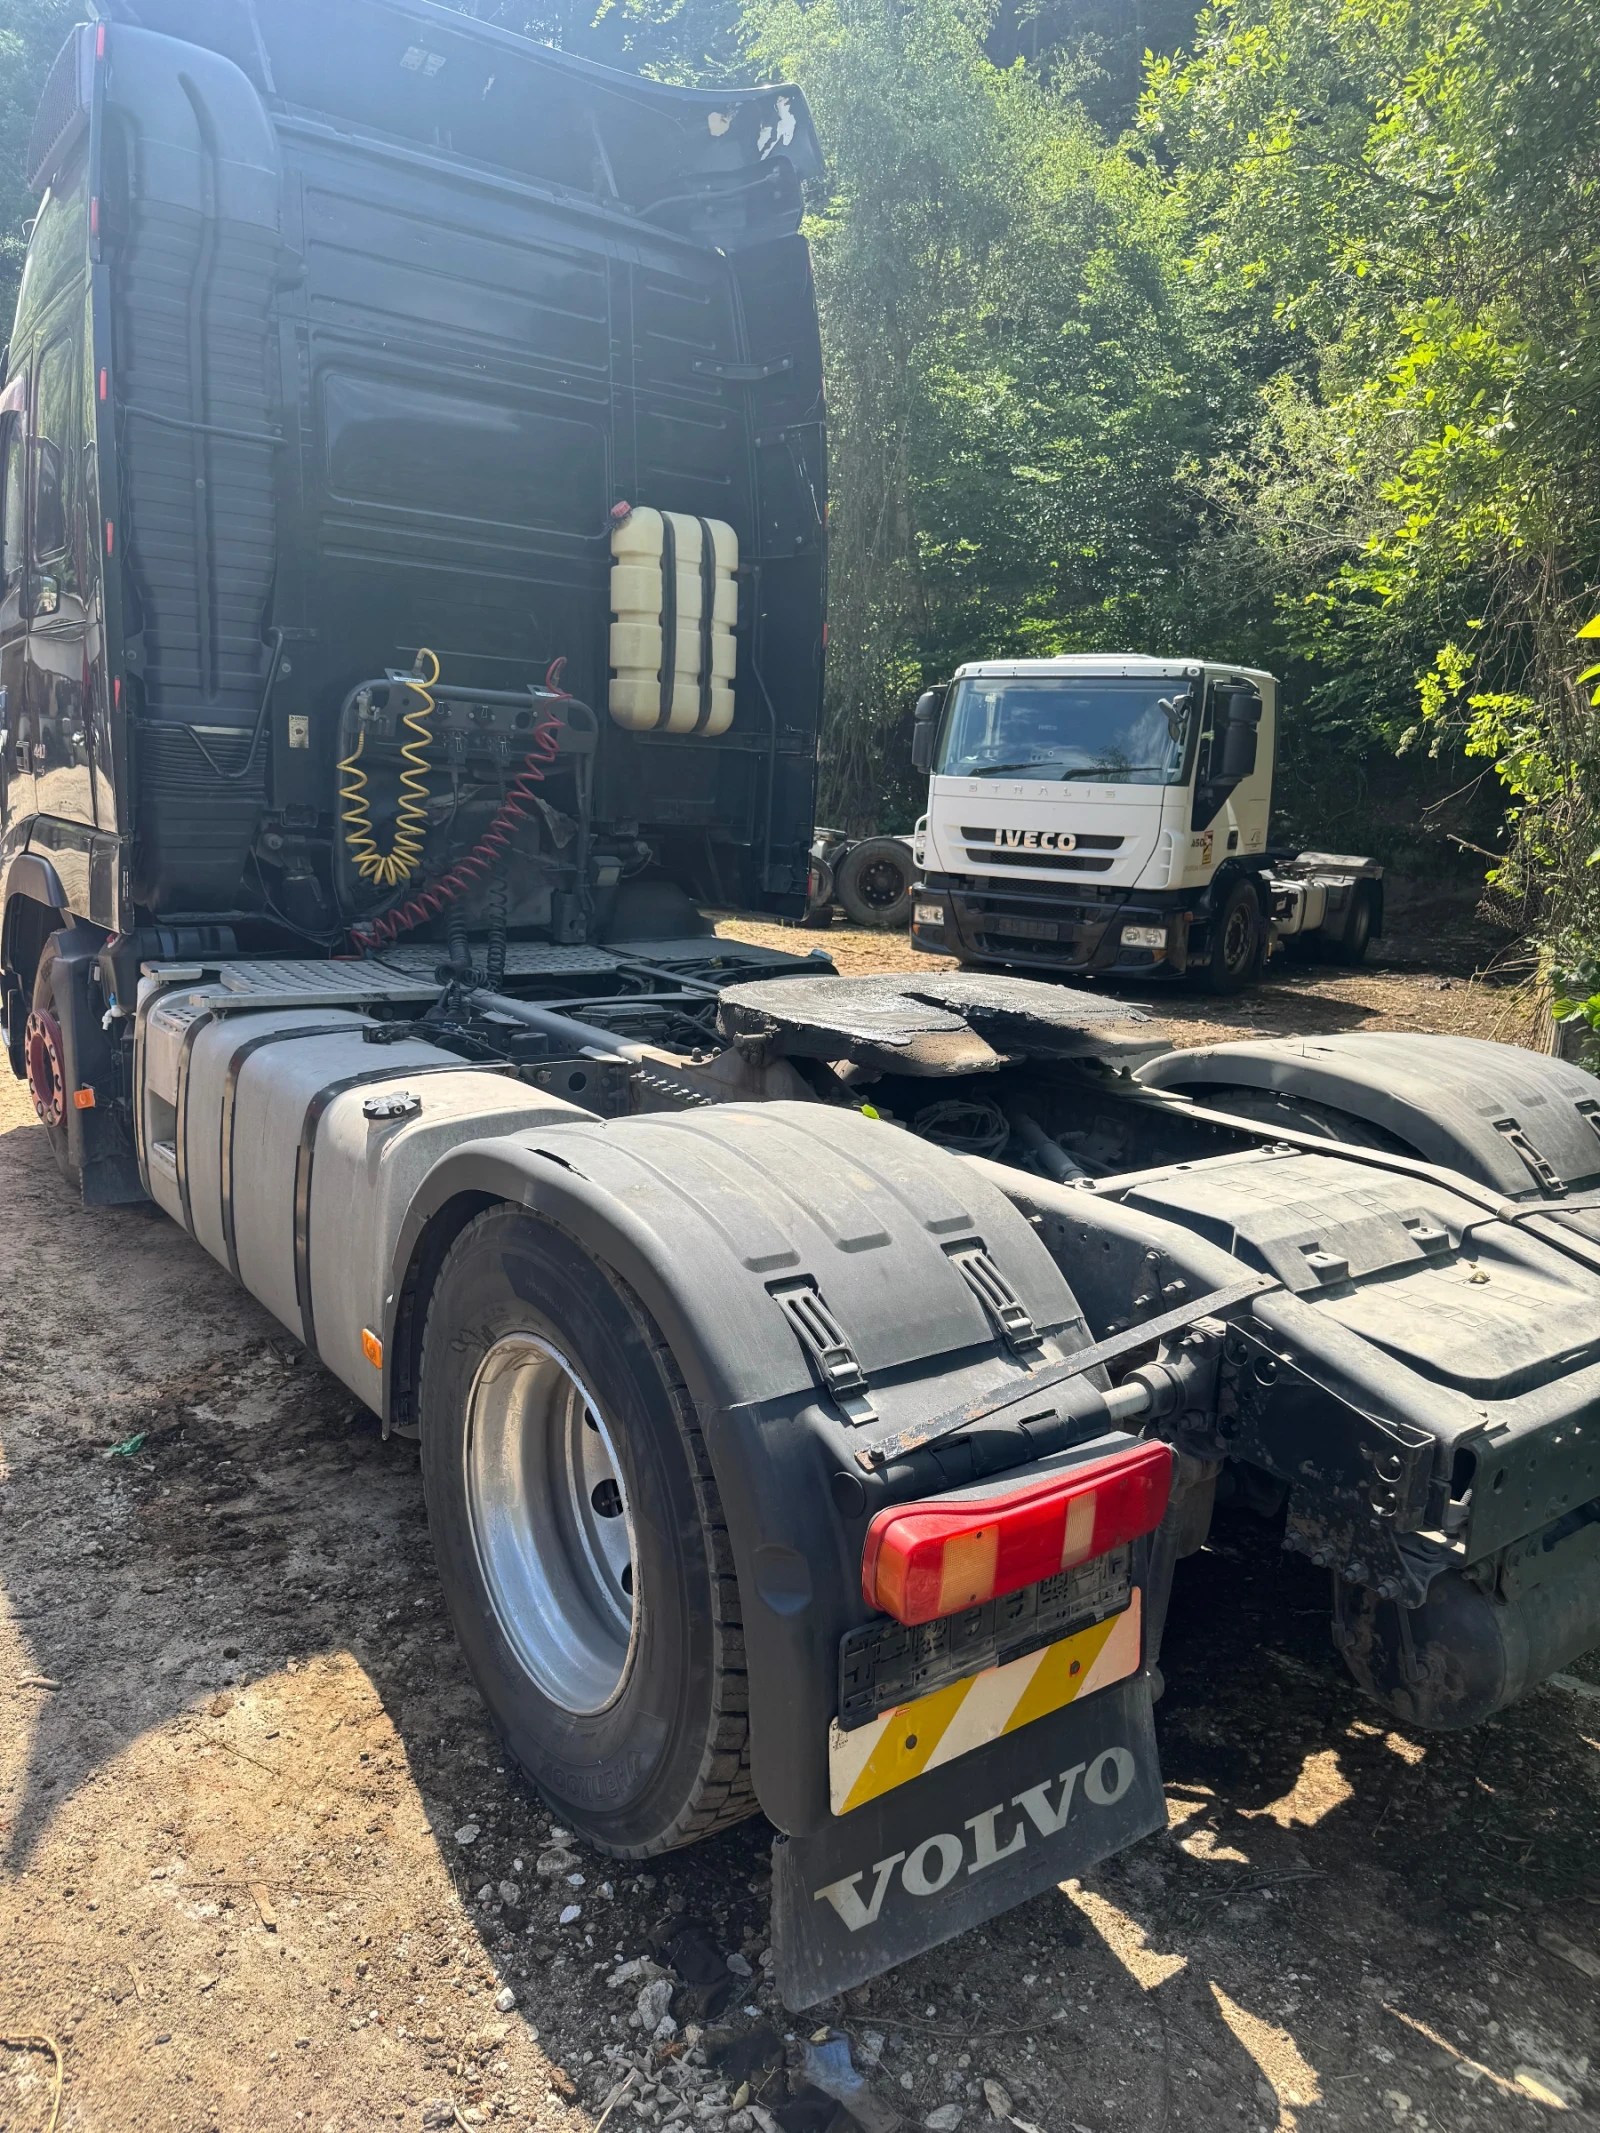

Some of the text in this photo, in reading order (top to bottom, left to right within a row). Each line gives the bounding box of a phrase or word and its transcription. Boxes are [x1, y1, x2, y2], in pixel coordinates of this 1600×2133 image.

[968, 782, 1116, 799] STRALIS
[994, 828, 1077, 851] IVECO
[814, 1746, 1136, 1932] VOLVO
